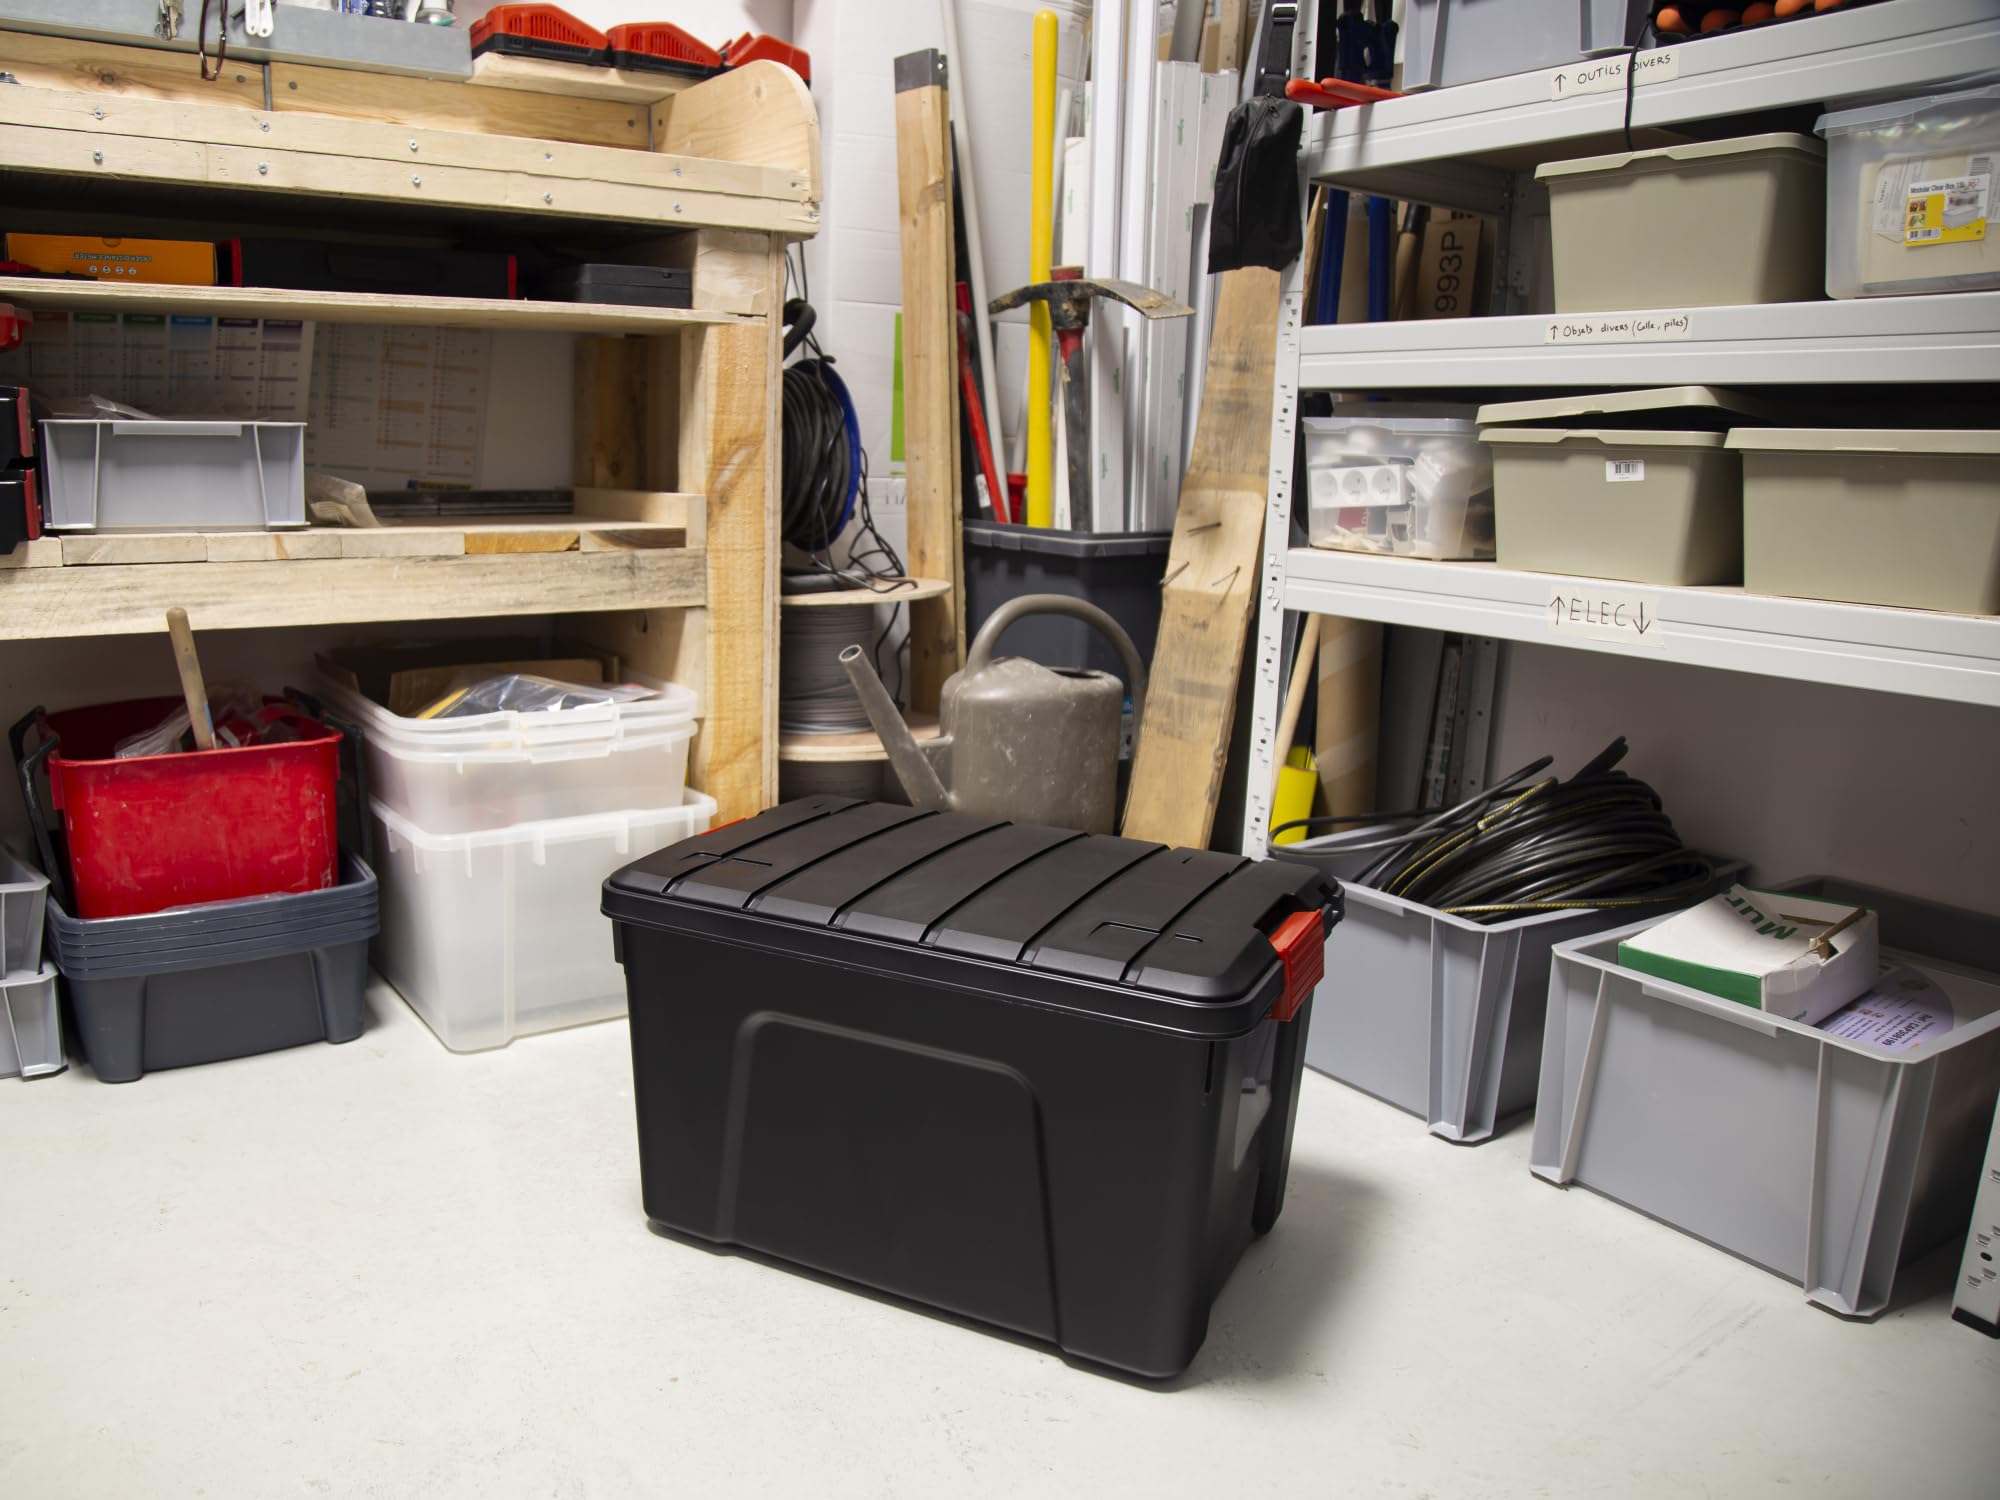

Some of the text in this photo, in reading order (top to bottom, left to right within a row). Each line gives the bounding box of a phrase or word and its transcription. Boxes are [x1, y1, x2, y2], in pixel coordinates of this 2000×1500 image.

[1434, 231, 1464, 312] 993P
[1563, 323, 1593, 337] Objets
[1600, 323, 1629, 333] divers
[1569, 598, 1627, 626] ELEC
[1722, 888, 1799, 940] Mur
